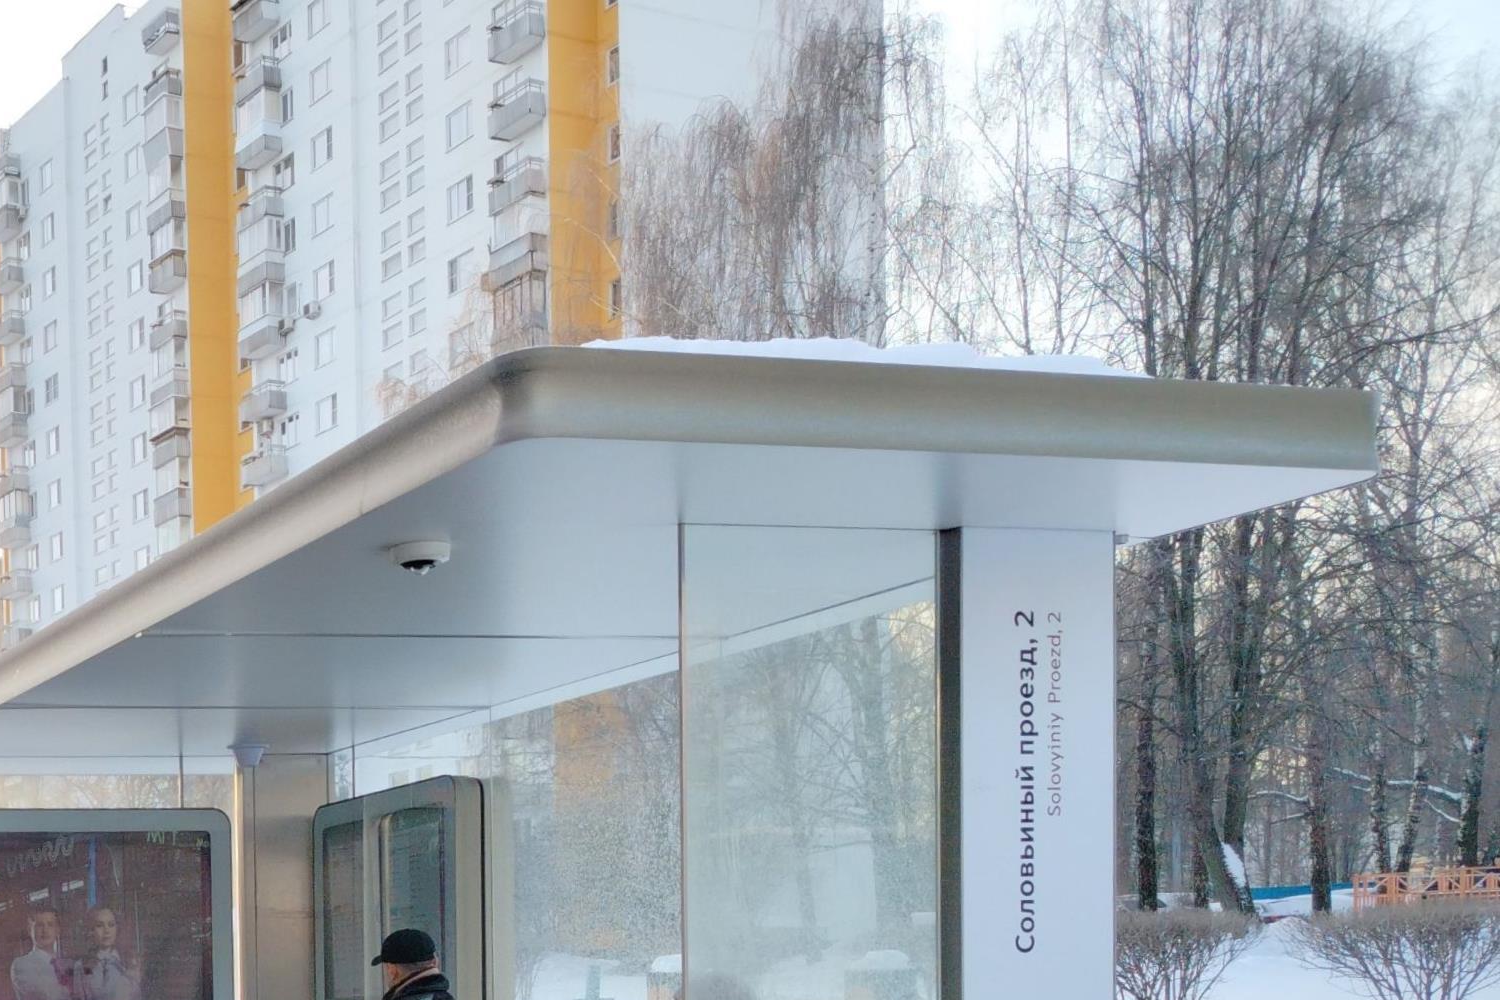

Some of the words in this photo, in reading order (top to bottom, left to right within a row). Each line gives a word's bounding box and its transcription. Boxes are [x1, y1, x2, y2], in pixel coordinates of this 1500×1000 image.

[1014, 610, 1035, 627] 2
[1047, 611, 1062, 622] 2
[1019, 638, 1039, 755] проезд,
[1047, 629, 1063, 704] Proezd,
[1047, 713, 1064, 817] Solovyiniy
[1014, 767, 1036, 954] Соловьиный
